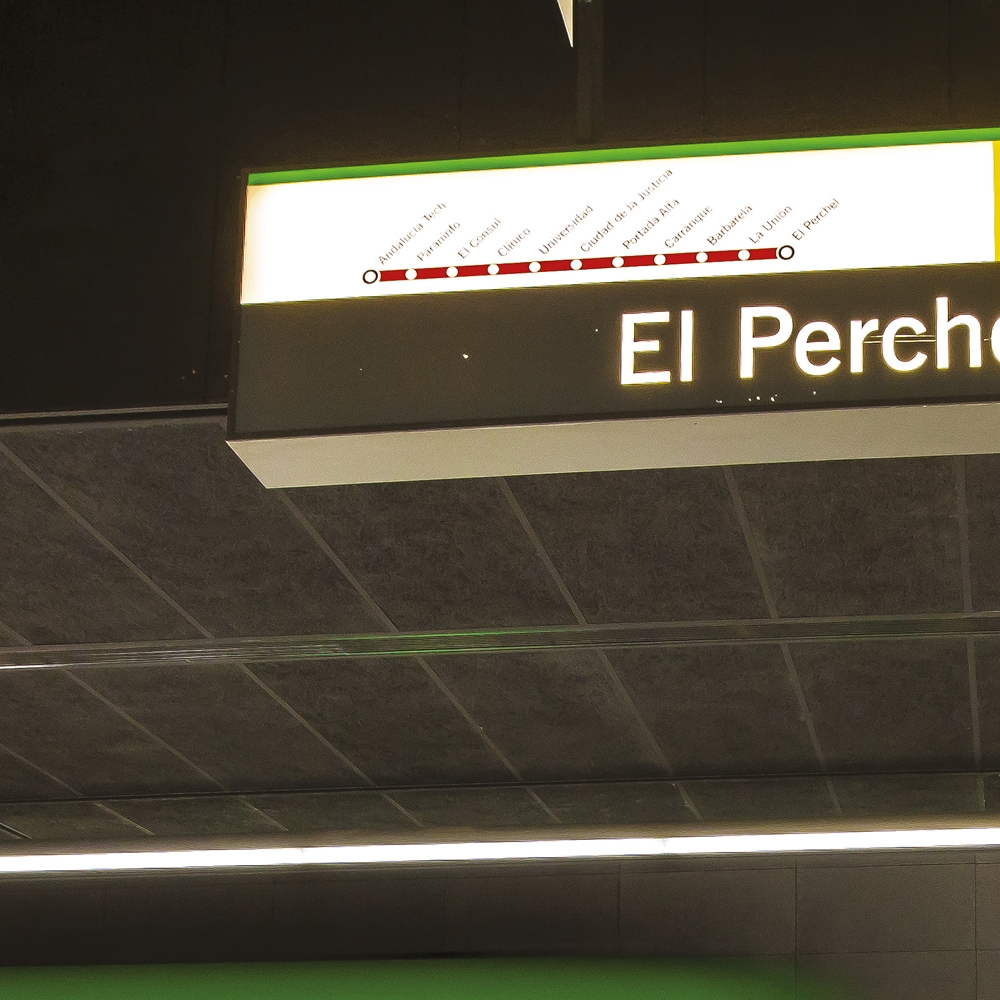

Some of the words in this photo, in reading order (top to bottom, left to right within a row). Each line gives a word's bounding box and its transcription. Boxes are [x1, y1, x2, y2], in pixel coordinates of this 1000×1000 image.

[538, 205, 594, 255] Universidad
[580, 220, 615, 253] Ciudad
[614, 209, 628, 223] de
[626, 200, 638, 211] la
[637, 168, 673, 201] Justicia
[622, 215, 660, 250] Portada
[658, 199, 680, 217] Alta
[664, 204, 713, 249] Carranque
[706, 204, 753, 246] Barbarela
[791, 228, 806, 241] El
[803, 198, 841, 228] Perchel
[457, 246, 471, 259] El
[748, 231, 764, 244] La
[620, 309, 694, 385] El
